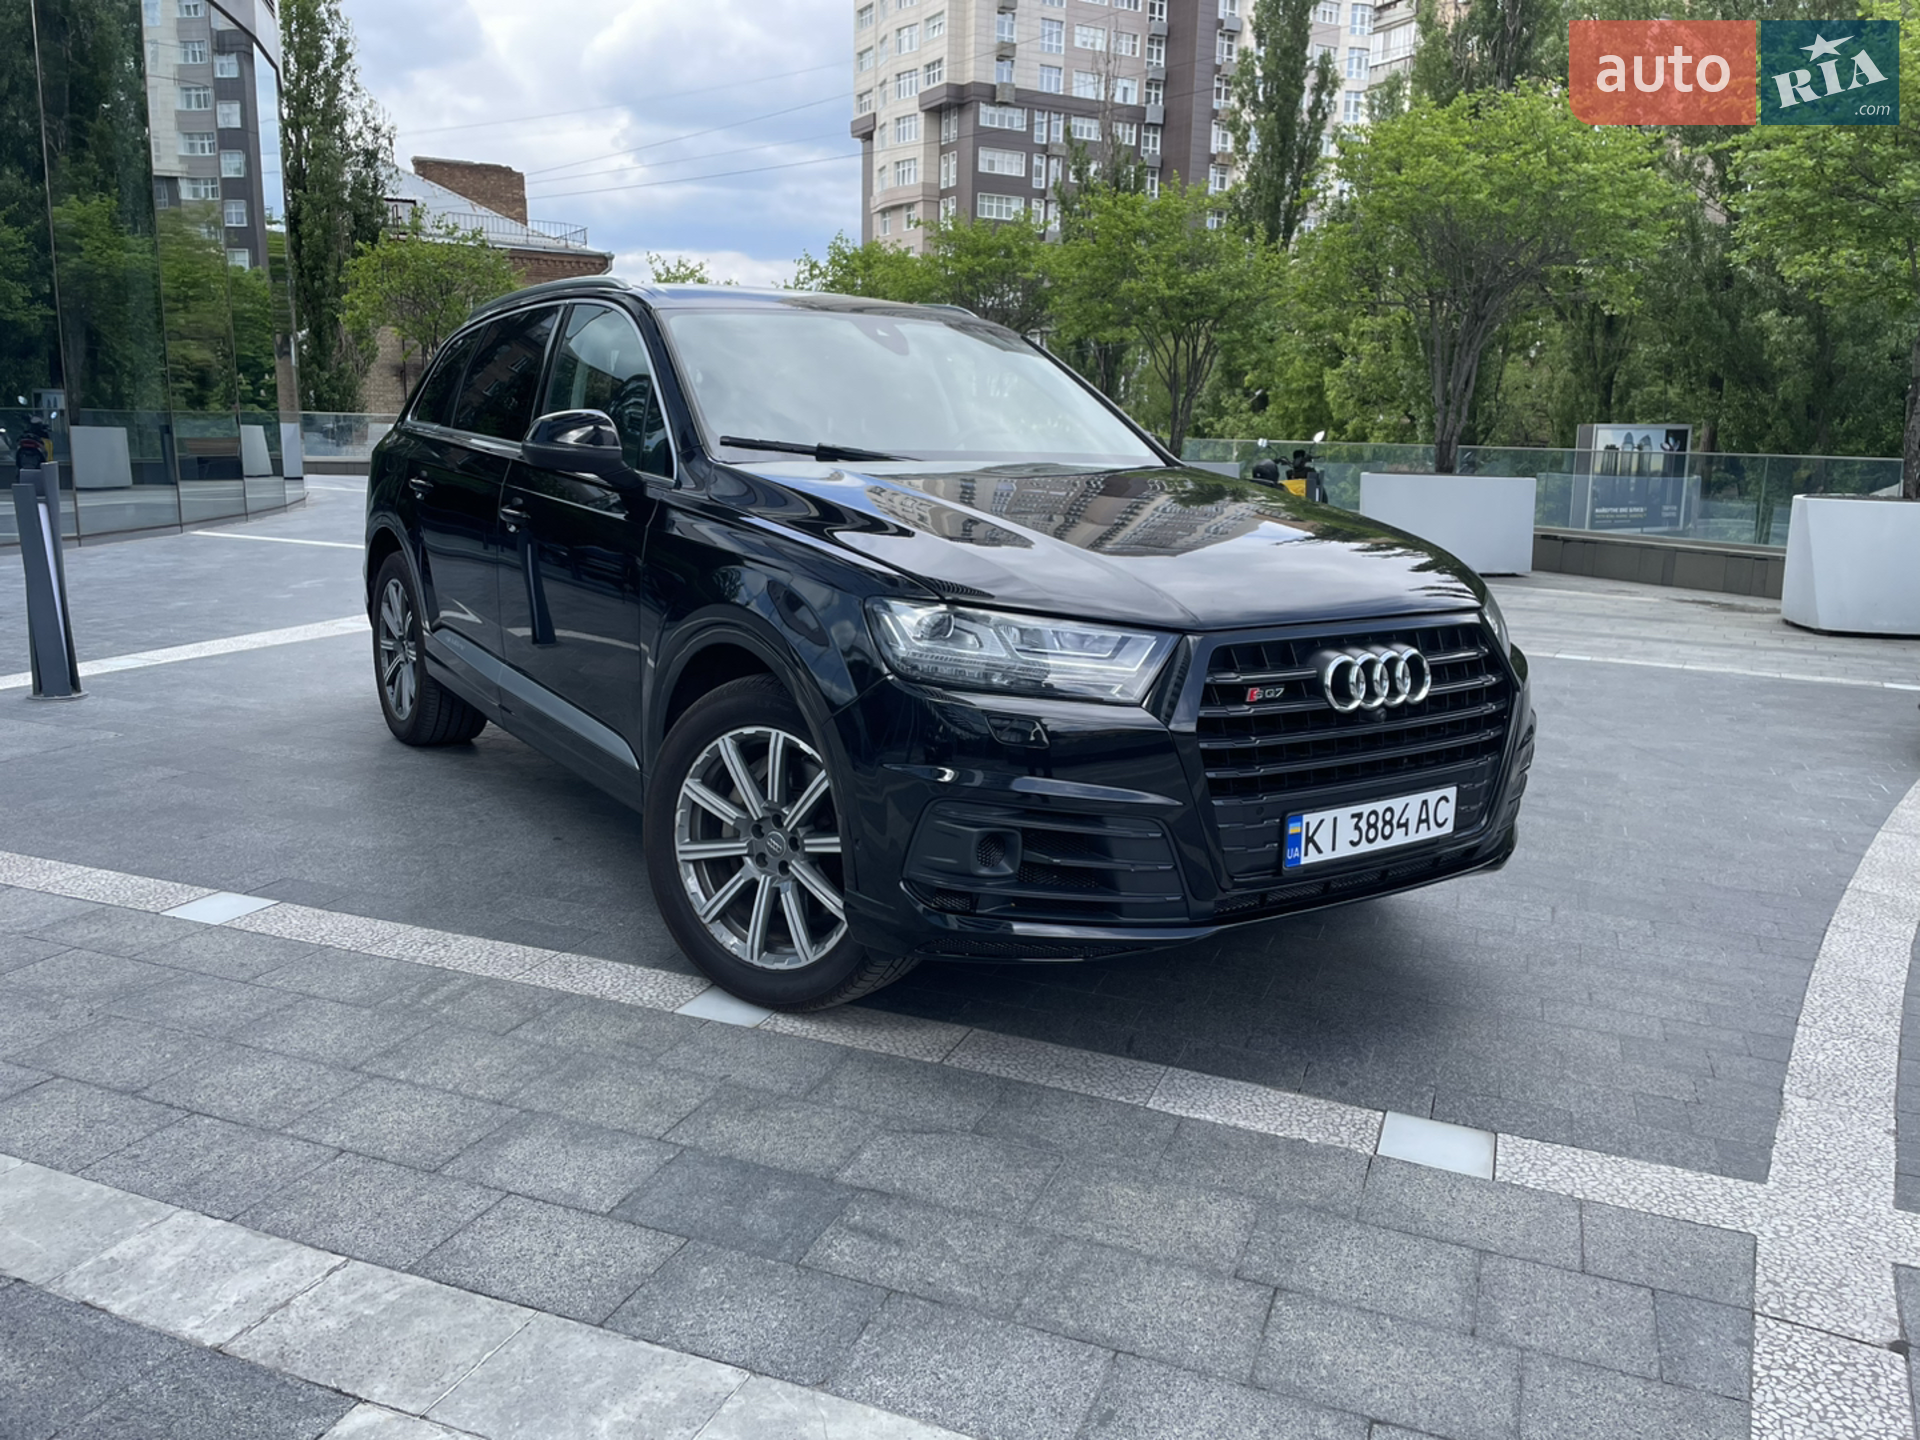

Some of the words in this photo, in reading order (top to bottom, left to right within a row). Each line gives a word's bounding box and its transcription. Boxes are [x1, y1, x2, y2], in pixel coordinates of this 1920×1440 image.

[1303, 816, 1338, 857] KI
[1348, 802, 1410, 847] 3884
[1415, 795, 1450, 834] AC
[1287, 847, 1300, 860] UA
